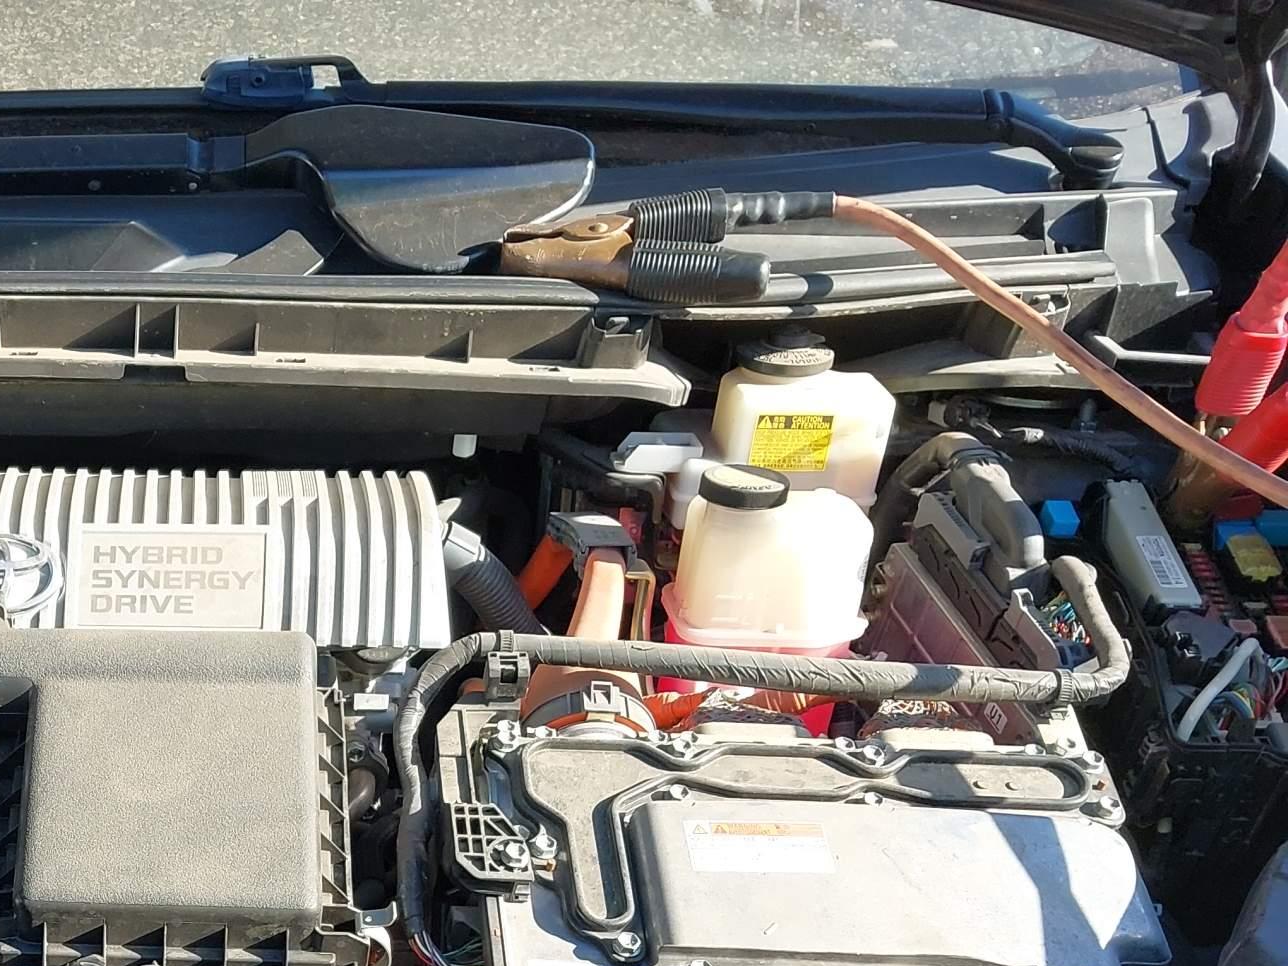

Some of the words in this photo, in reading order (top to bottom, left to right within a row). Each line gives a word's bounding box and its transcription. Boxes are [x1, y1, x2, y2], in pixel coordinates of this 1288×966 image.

[791, 422, 830, 430] ATTENTION
[792, 415, 823, 423] CAUTION
[93, 545, 224, 565] HYBRID
[91, 569, 254, 590] SYNERGY
[90, 594, 194, 614] DRIVE
[989, 704, 1002, 725] U1
